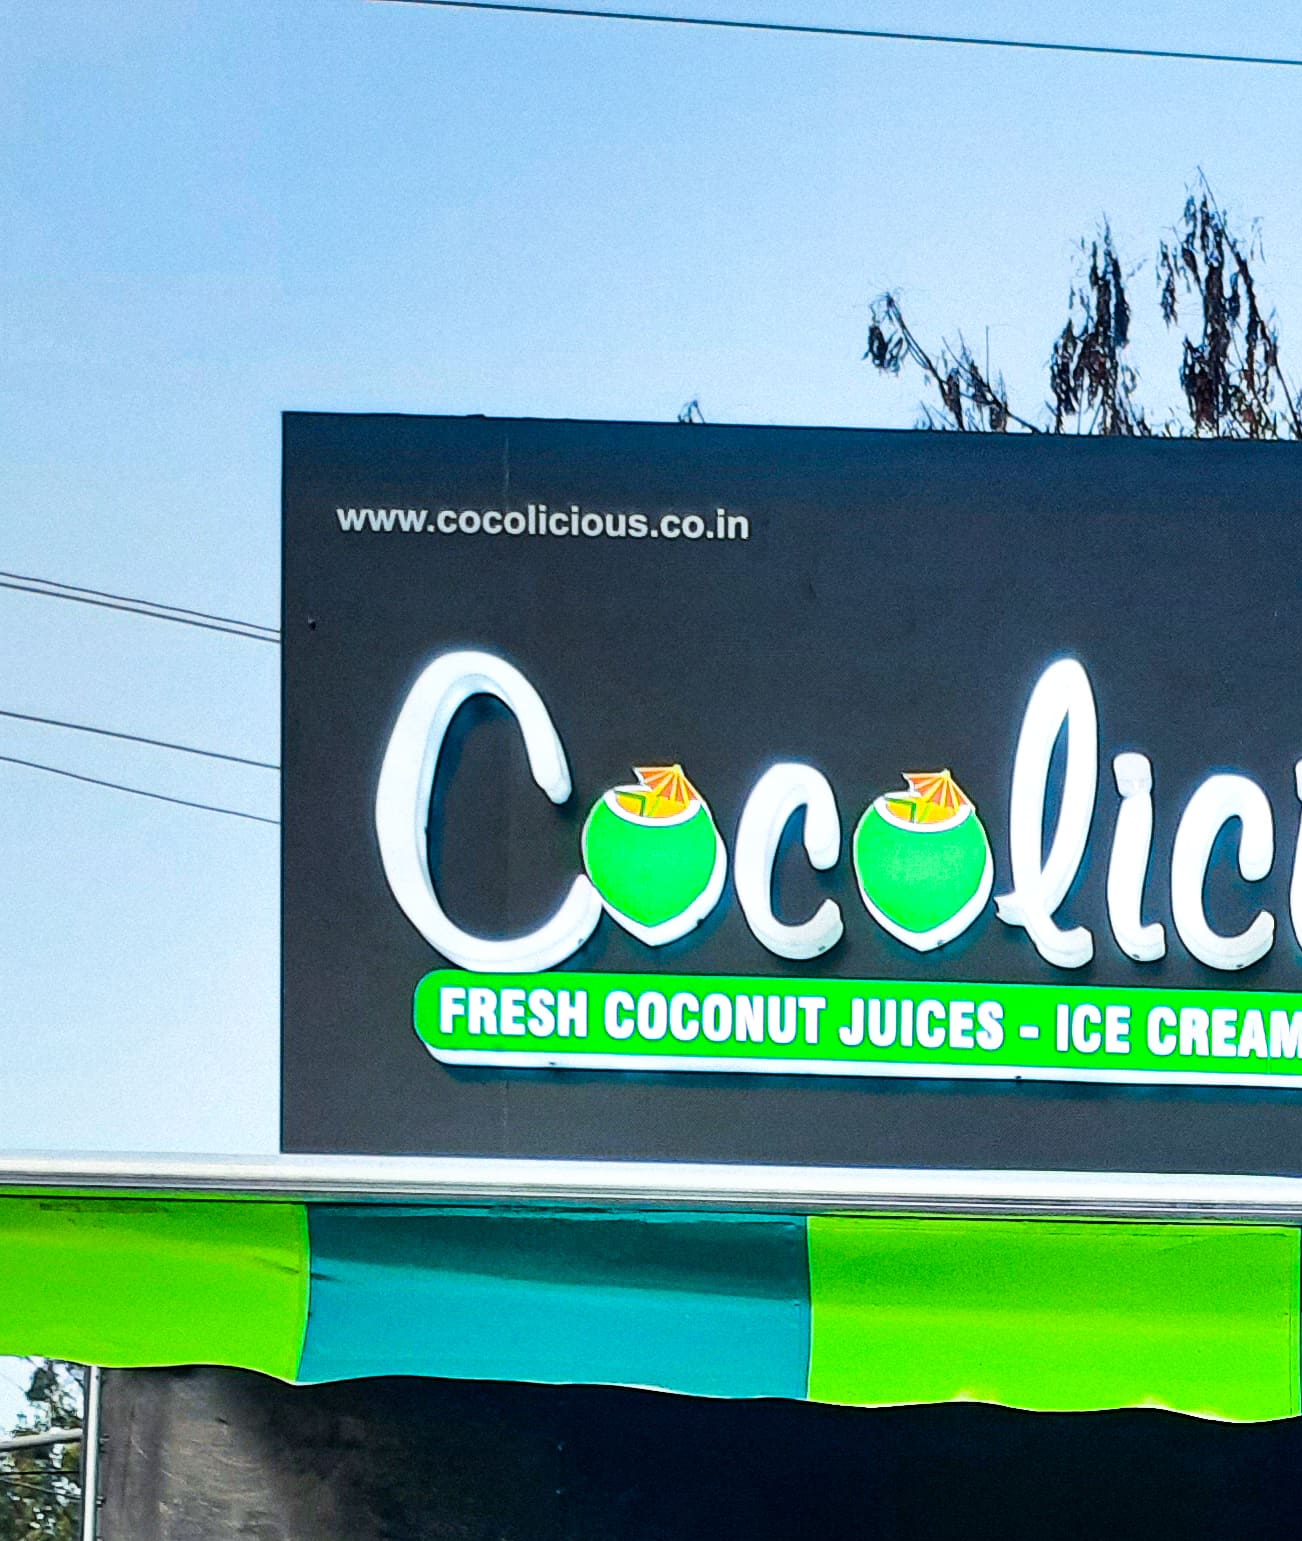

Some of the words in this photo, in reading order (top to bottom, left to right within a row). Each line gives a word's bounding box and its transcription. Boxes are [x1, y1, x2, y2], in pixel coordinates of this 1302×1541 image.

[336, 504, 750, 541] www.cocolicious.co.in
[439, 986, 588, 1038] FRESH
[603, 990, 827, 1045] COCONUT
[837, 997, 1005, 1051] JUICES
[1055, 1003, 1132, 1055] ICE
